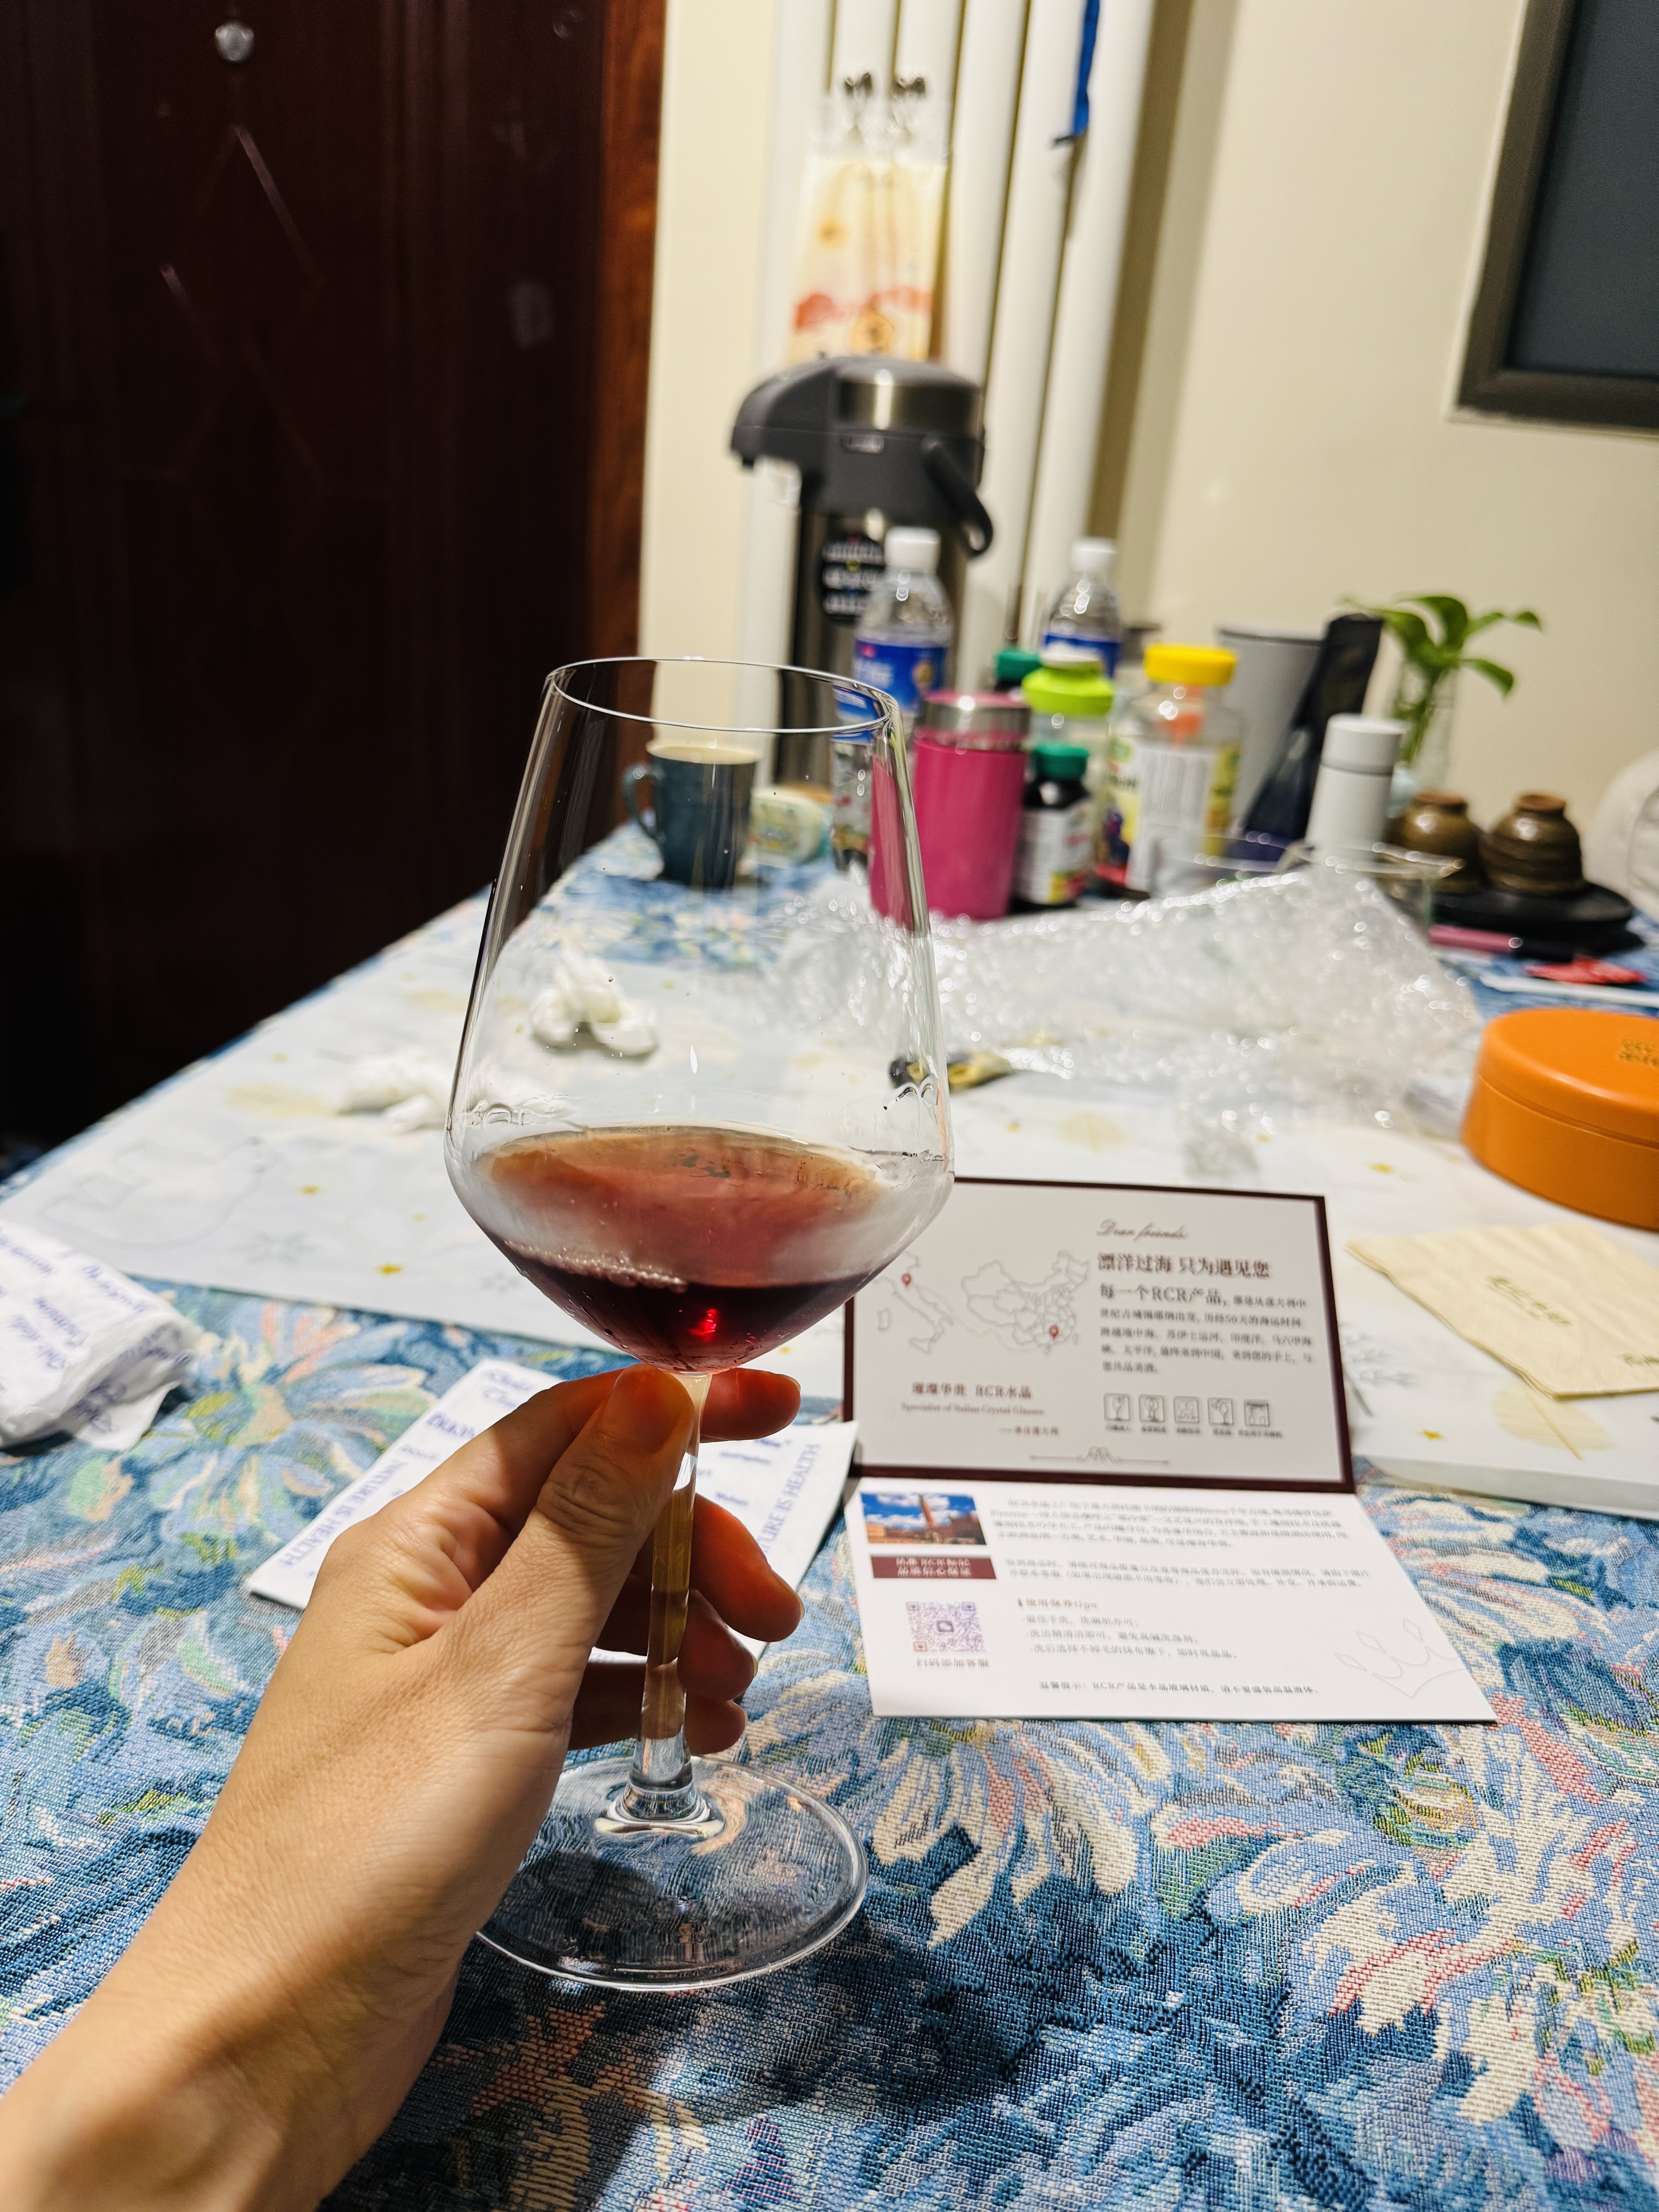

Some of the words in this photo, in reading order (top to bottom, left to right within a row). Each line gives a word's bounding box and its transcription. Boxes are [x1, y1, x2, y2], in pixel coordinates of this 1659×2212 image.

[1097, 1252, 1173, 1273] 漂洋过海
[1178, 1256, 1271, 1279] 只为遇见您
[782, 1443, 821, 1497] HEALTH
[775, 1497, 794, 1513] IS
[756, 1510, 786, 1553] TURE
